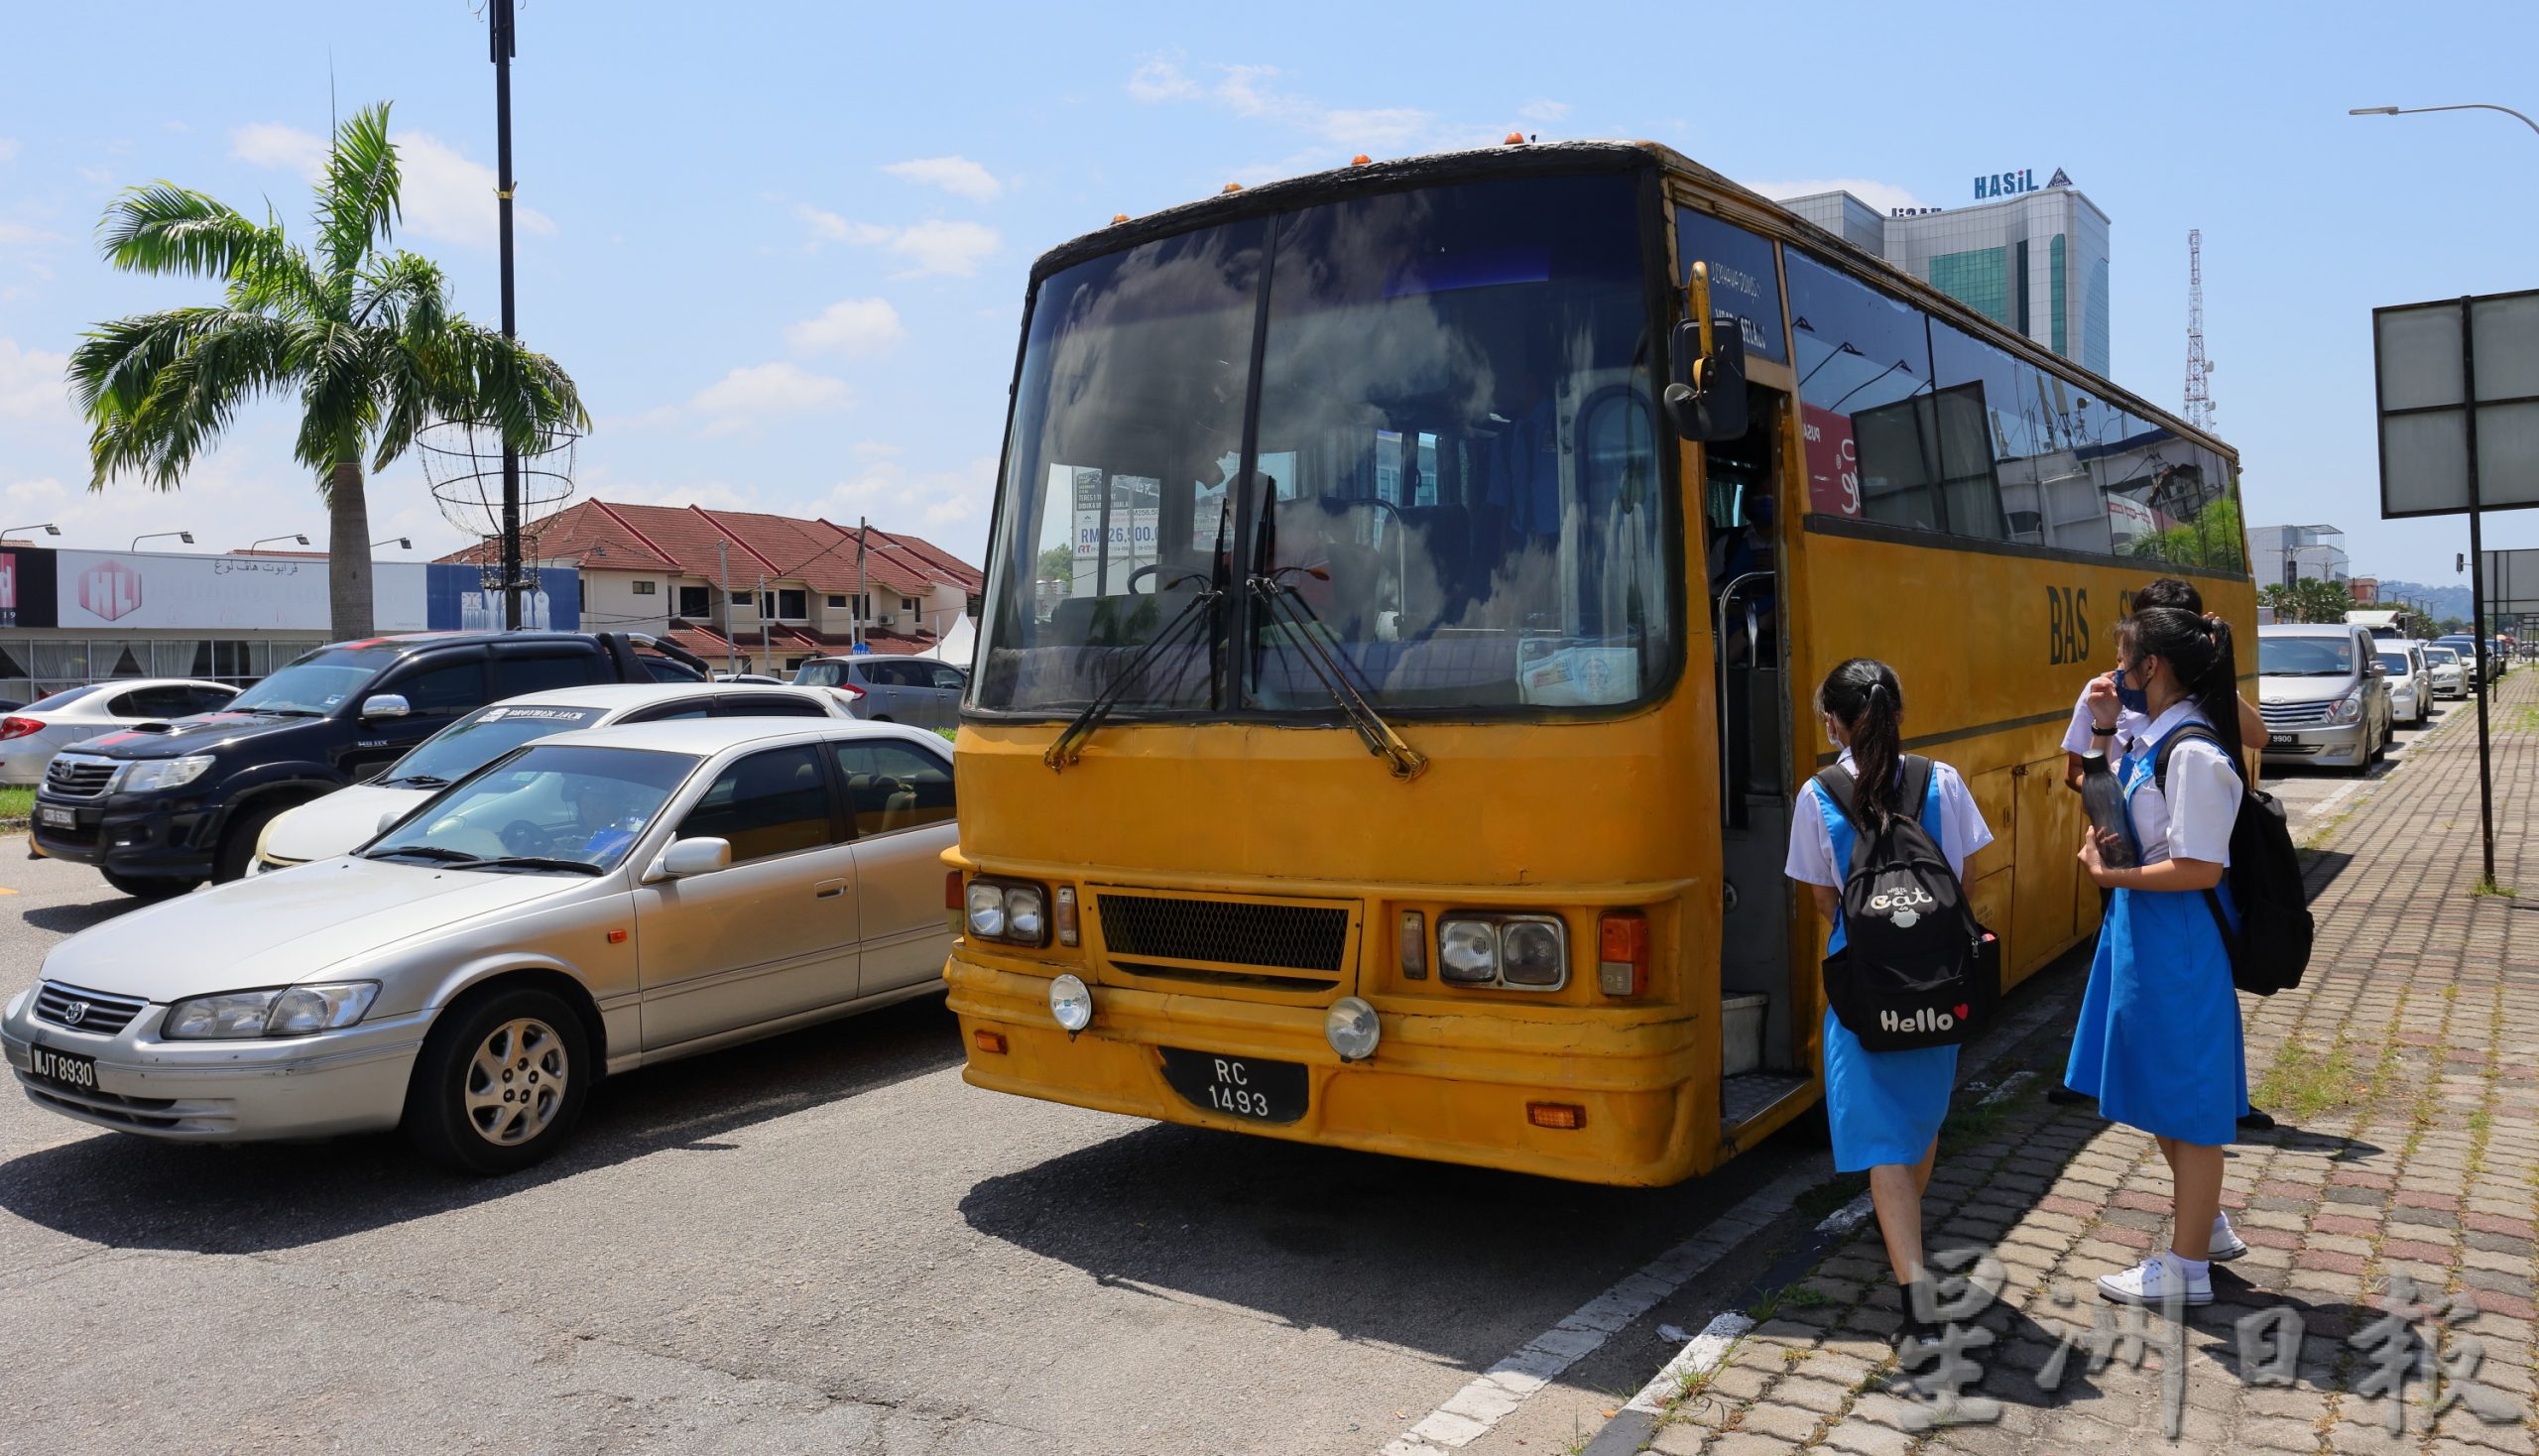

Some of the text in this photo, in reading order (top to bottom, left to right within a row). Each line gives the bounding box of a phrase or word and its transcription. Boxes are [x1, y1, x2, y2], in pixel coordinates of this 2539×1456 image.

[2046, 585, 2090, 666] BAS
[555, 711, 587, 721] JACK
[1880, 1008, 1954, 1032] Hello
[34, 1049, 93, 1087] WJT 8930
[1214, 1058, 1248, 1085] RC
[1208, 1085, 1269, 1117] 1493
